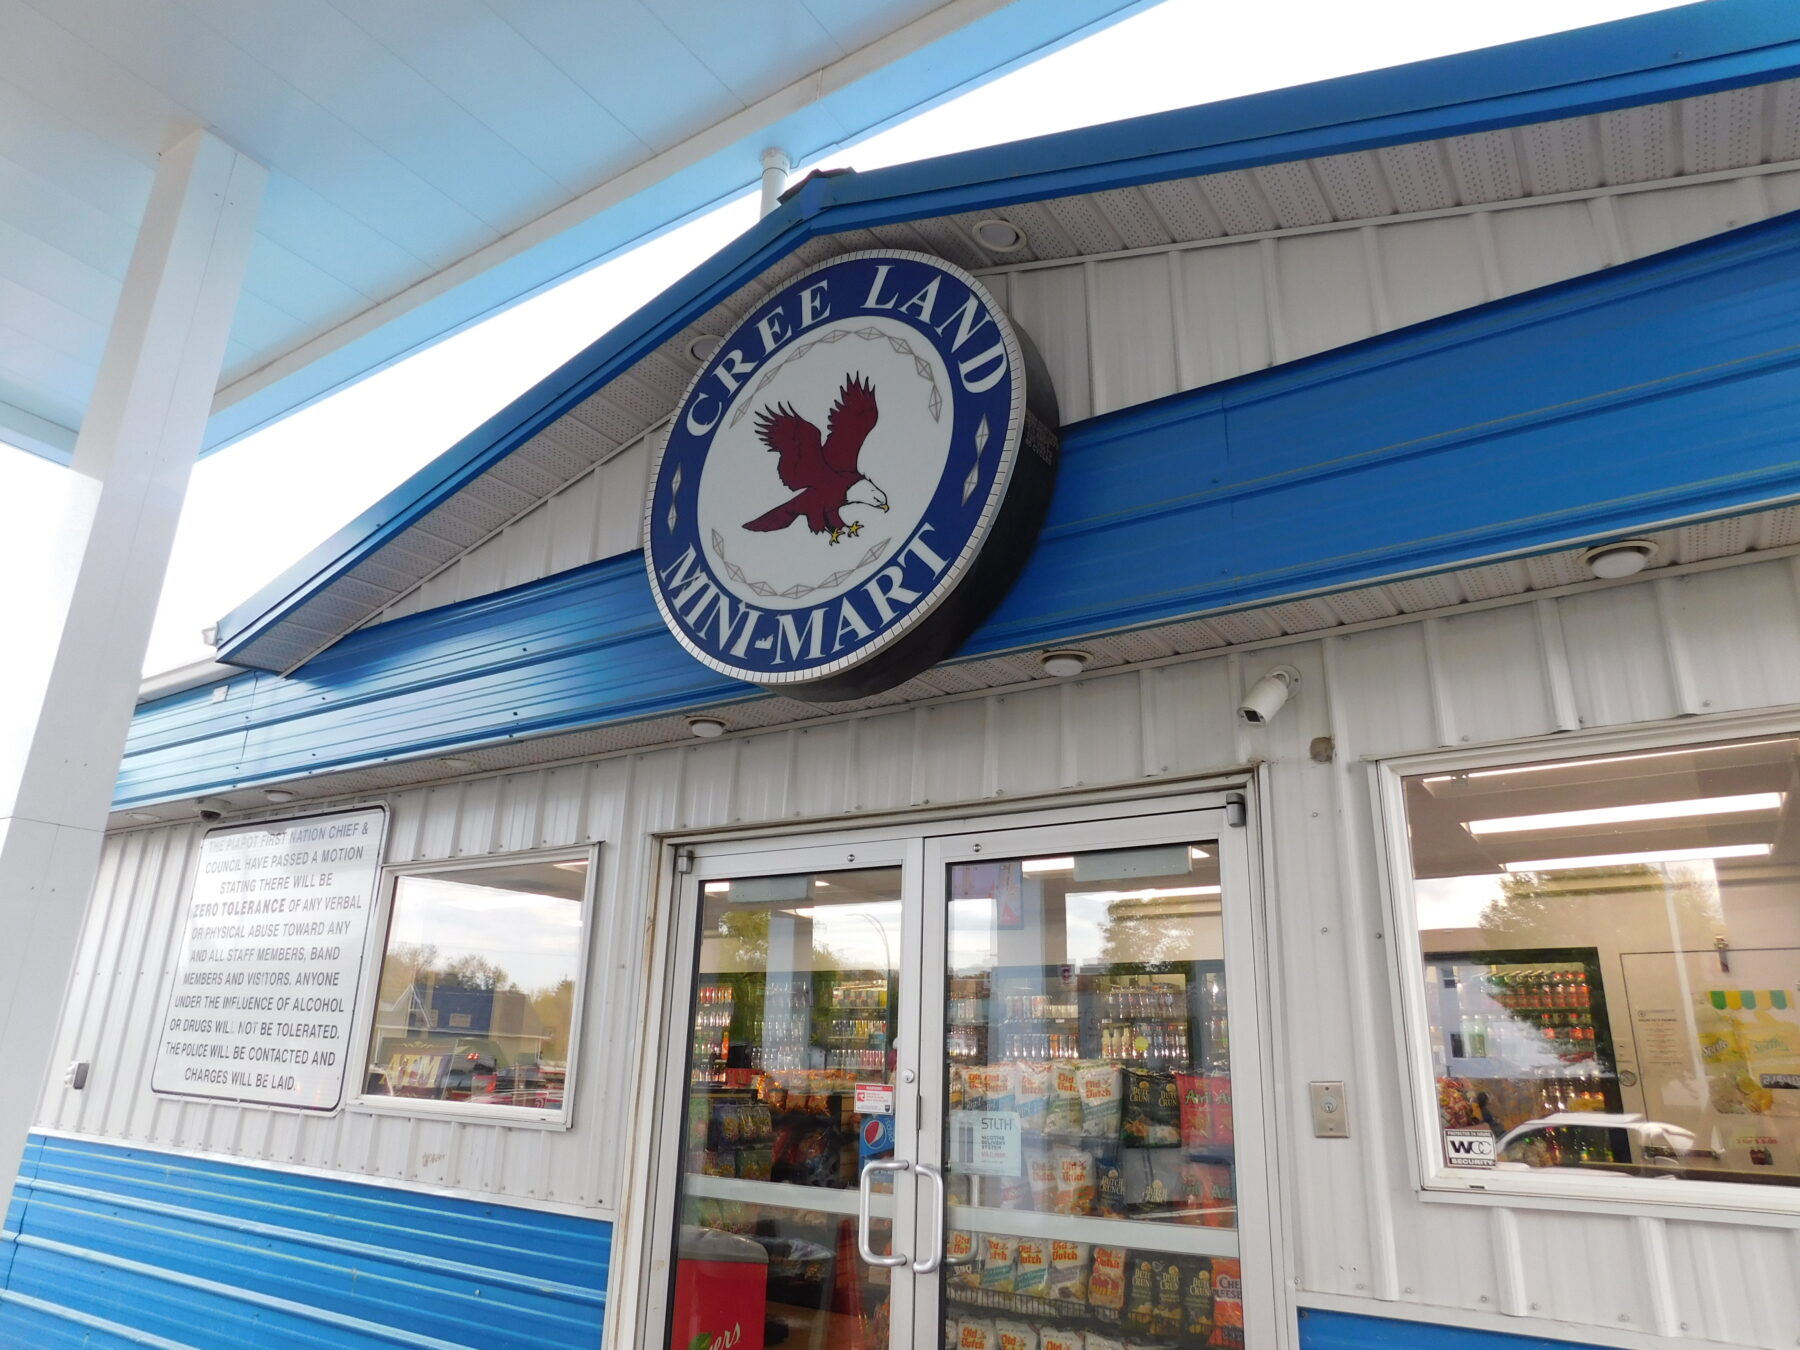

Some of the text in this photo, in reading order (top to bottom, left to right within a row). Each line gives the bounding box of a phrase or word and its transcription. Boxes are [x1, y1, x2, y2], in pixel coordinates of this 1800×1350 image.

[686, 264, 1010, 437] CREE LAND
[659, 521, 954, 666] MINI-MART
[290, 827, 325, 844] NATION
[328, 822, 360, 839] CHIEF
[362, 822, 368, 834] &
[206, 846, 364, 874] COUNCIL HAVE PASSED A MOTION
[220, 872, 333, 894] STATING THERE WILL BE
[192, 895, 362, 918] ZERO TOLERANCE OF ANY VERBAL
[192, 920, 351, 940] OR PHYSICAL ABUSE TOWARD ANY
[190, 946, 341, 962] AND ALL STAFF MEMBERS, BAND
[183, 972, 223, 986] MEMBERS
[225, 972, 245, 986] AND
[295, 972, 340, 986] ANYONE
[174, 996, 344, 1013] UNDER THE INFLUENCE OF ALCOHOL
[170, 1018, 181, 1031] OR
[183, 1018, 212, 1033] DRUGS
[238, 1021, 258, 1035] NOT
[260, 1022, 272, 1036] BE
[276, 1023, 340, 1040] TOLERATED.
[166, 1041, 336, 1066] THE POLICE WILL BE CONTACTED AND
[1702, 1038, 1728, 1057] Sprite
[184, 1067, 296, 1091] CHARGES WILL BE LAID.
[1450, 1140, 1492, 1155] WCC
[1452, 1158, 1494, 1166] SECURITY
[954, 1244, 970, 1254] Dut
[1052, 1250, 1078, 1261] Dutch
[962, 1326, 978, 1338] Old
[1001, 1334, 1016, 1346] Old
